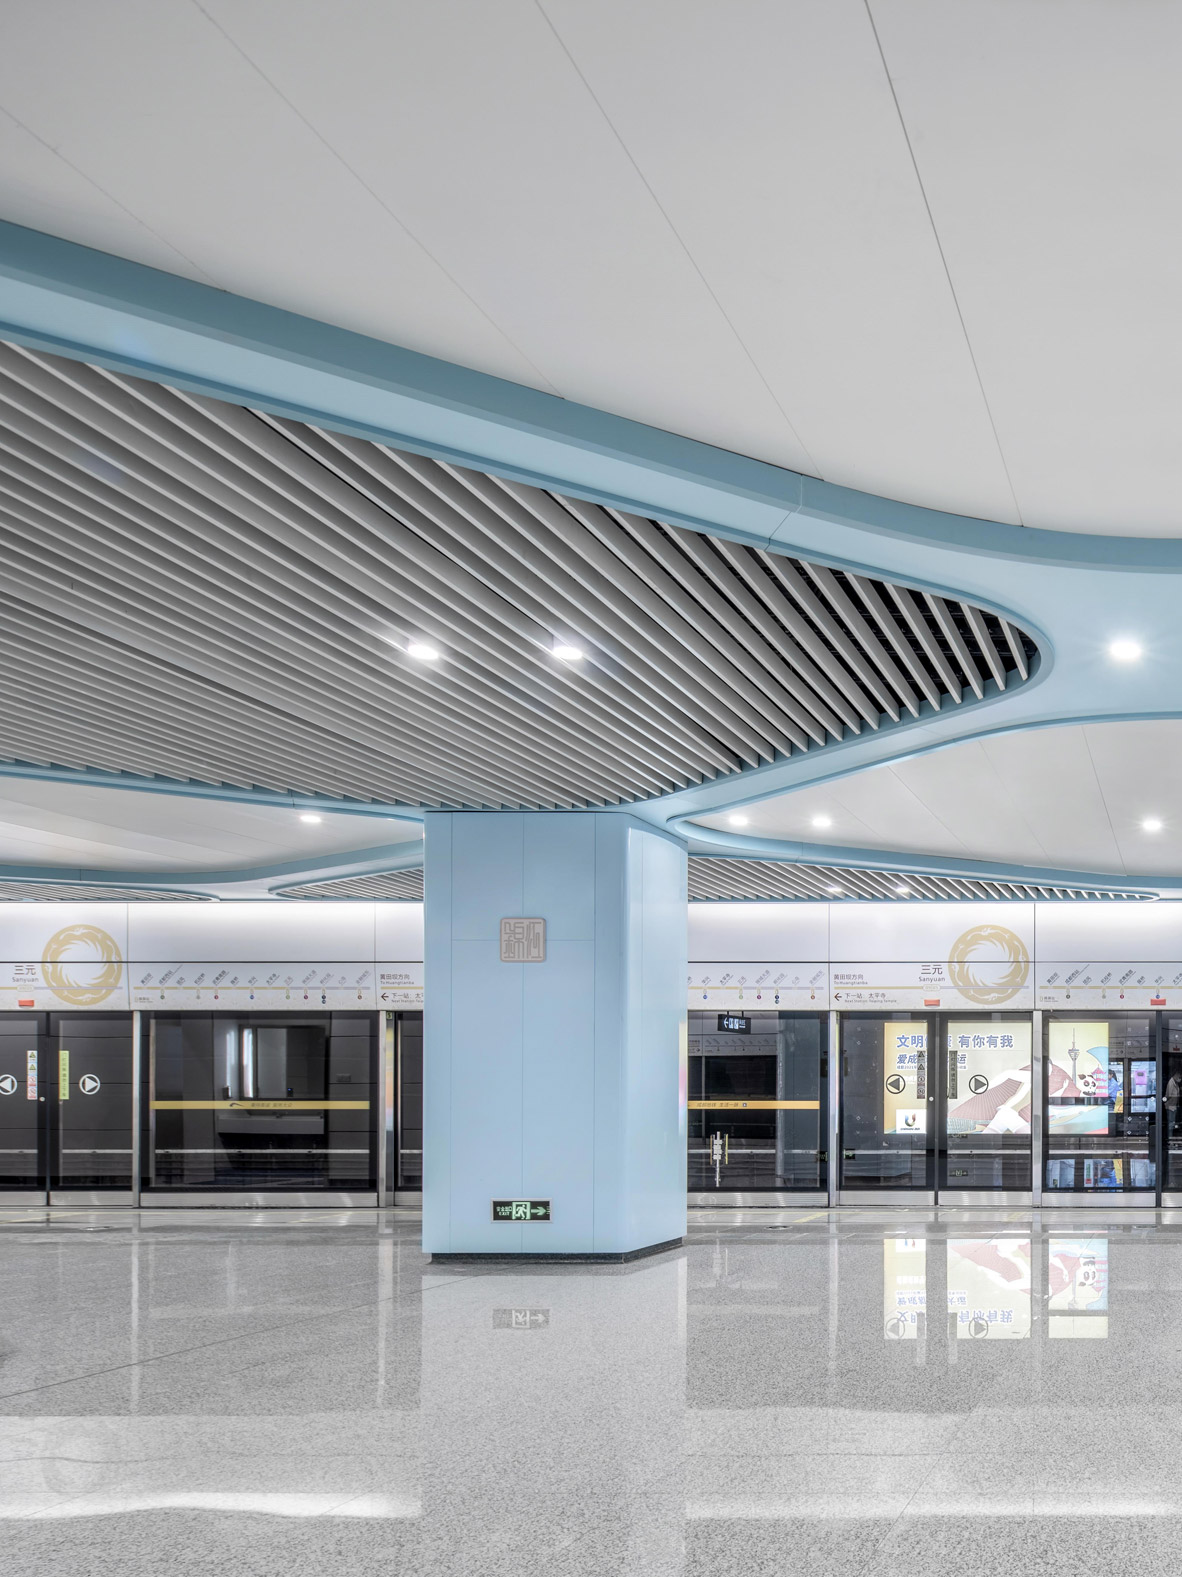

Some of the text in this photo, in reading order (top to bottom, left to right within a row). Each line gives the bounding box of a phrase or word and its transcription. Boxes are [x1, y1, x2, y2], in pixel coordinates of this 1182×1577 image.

[14, 965, 36, 975] 三元
[921, 964, 943, 975] 三元
[958, 1035, 1014, 1048] 有你有我
